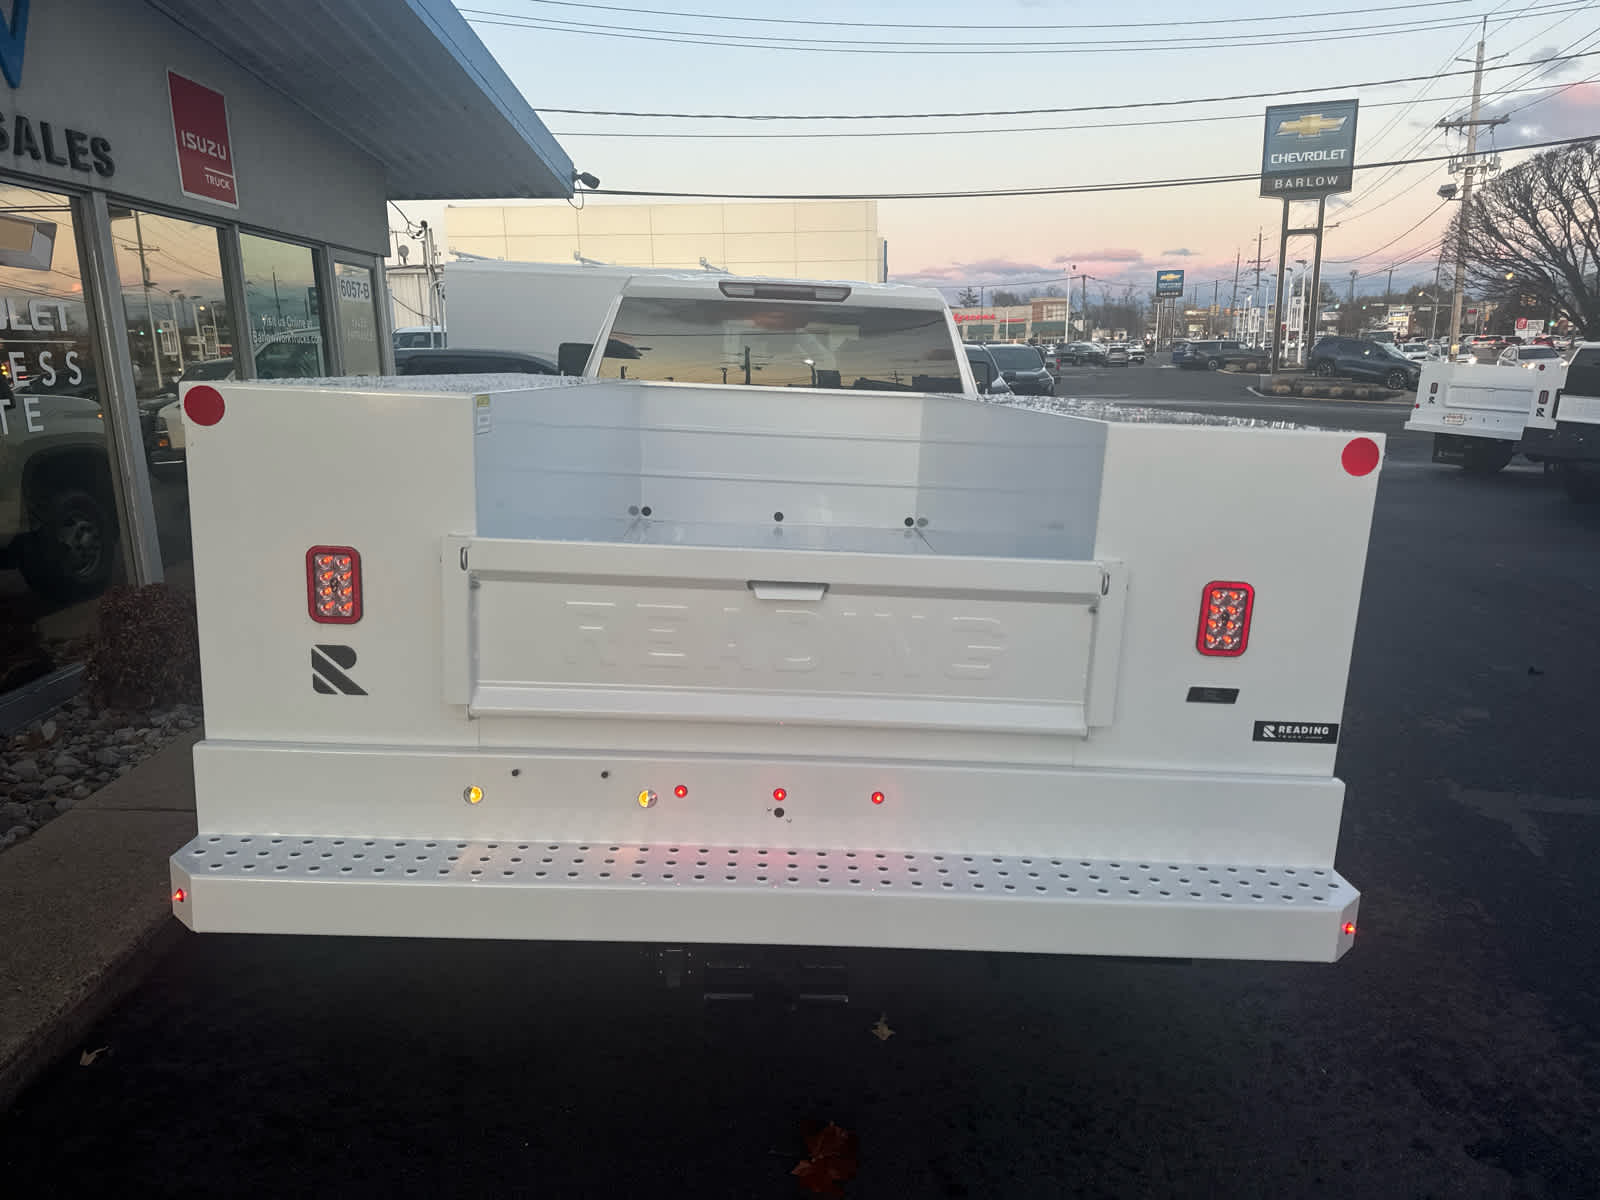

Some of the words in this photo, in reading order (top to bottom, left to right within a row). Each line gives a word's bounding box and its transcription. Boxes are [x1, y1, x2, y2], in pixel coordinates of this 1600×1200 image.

[181, 129, 227, 161] ISUZU
[1270, 148, 1348, 164] CHEVROLET
[205, 173, 232, 191] TRUCK
[1273, 175, 1338, 189] BARLOW
[8, 350, 82, 387] ESS
[1278, 725, 1329, 735] READING
